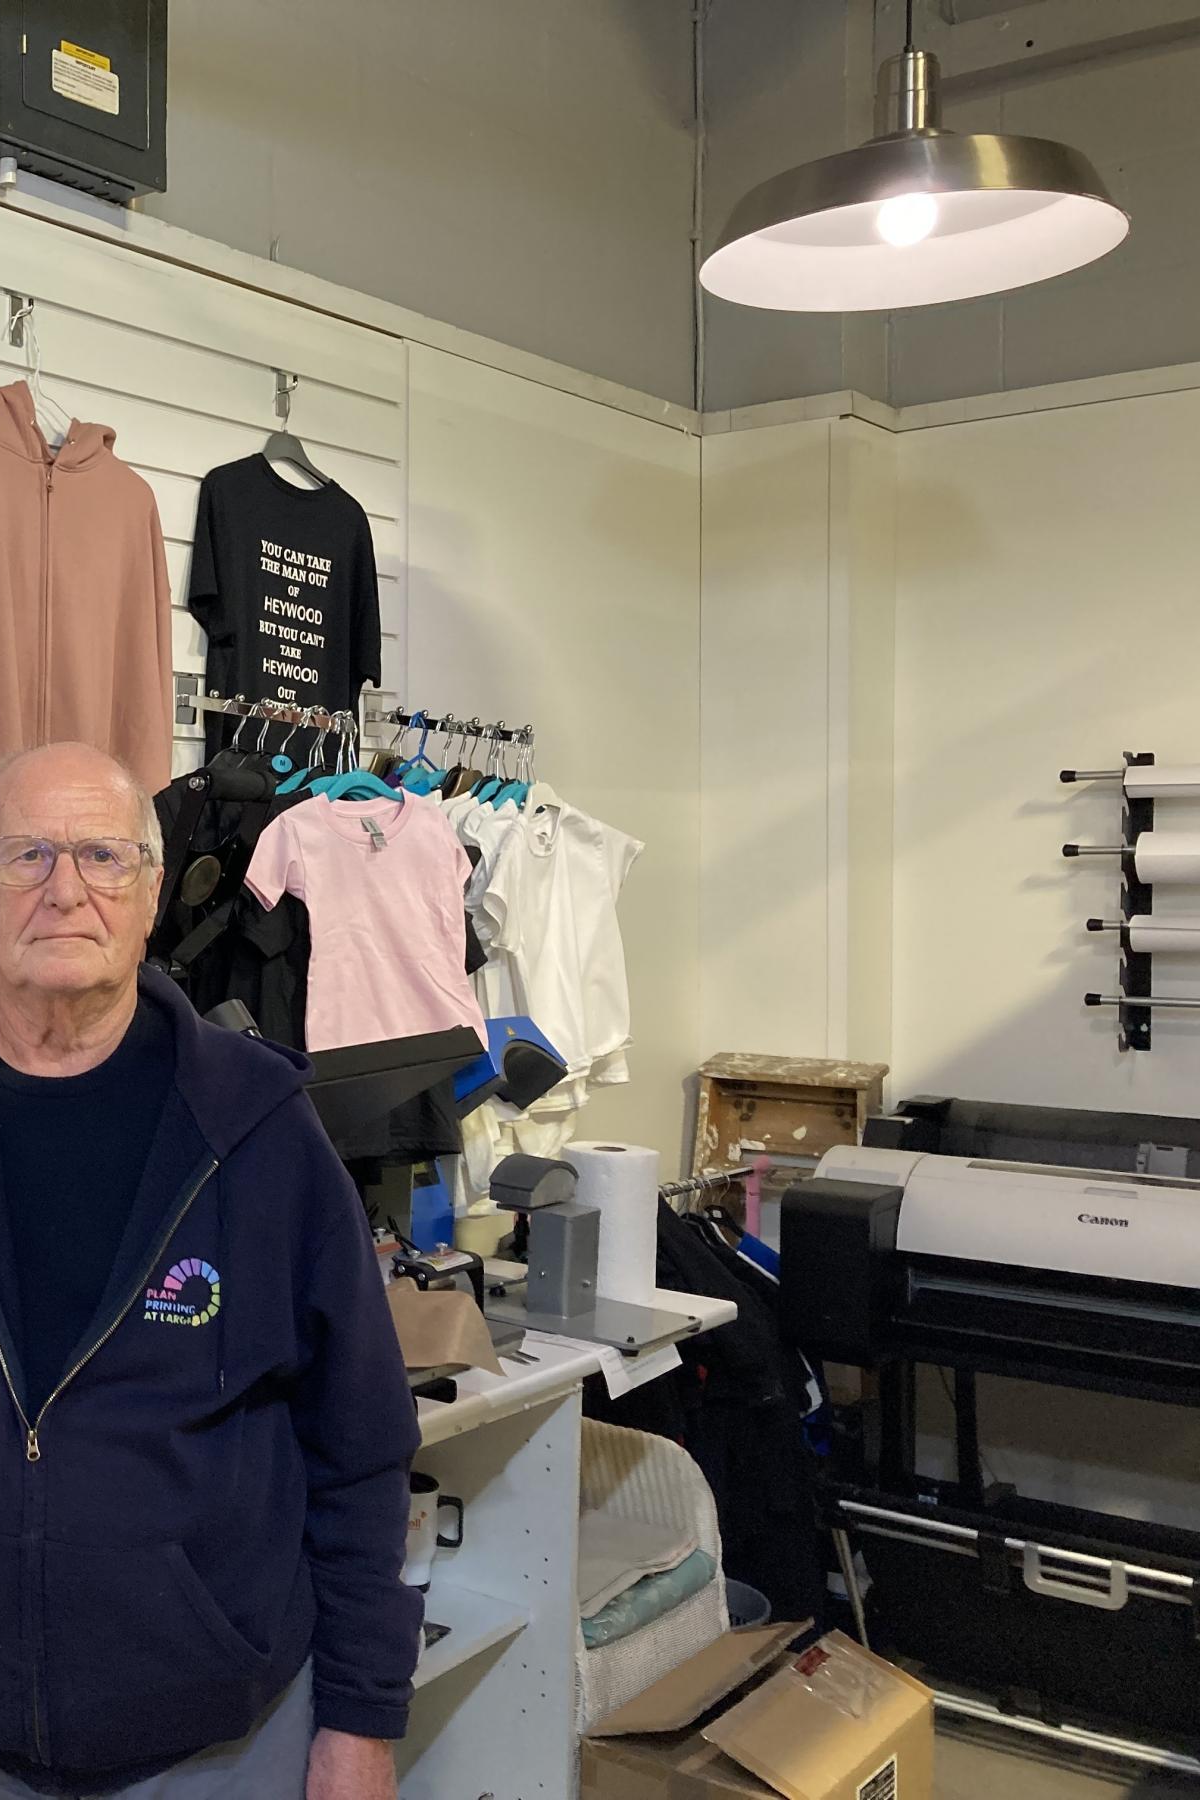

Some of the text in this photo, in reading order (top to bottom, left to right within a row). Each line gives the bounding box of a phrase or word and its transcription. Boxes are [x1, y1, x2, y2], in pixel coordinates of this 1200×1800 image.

[261, 540, 332, 573] YOU CAN TAKE
[260, 557, 328, 588] THE MAN OUT
[288, 585, 300, 598] OF
[264, 595, 323, 626] HEYWOOD
[259, 619, 278, 636] BUT
[278, 627, 298, 642] YOU
[280, 645, 302, 660] TAKE
[262, 657, 319, 685] HEYWOOD
[277, 686, 297, 701] OUT
[1077, 1213, 1129, 1228] Canon
[146, 1288, 177, 1301] PLAN
[144, 1311, 158, 1321] AT
